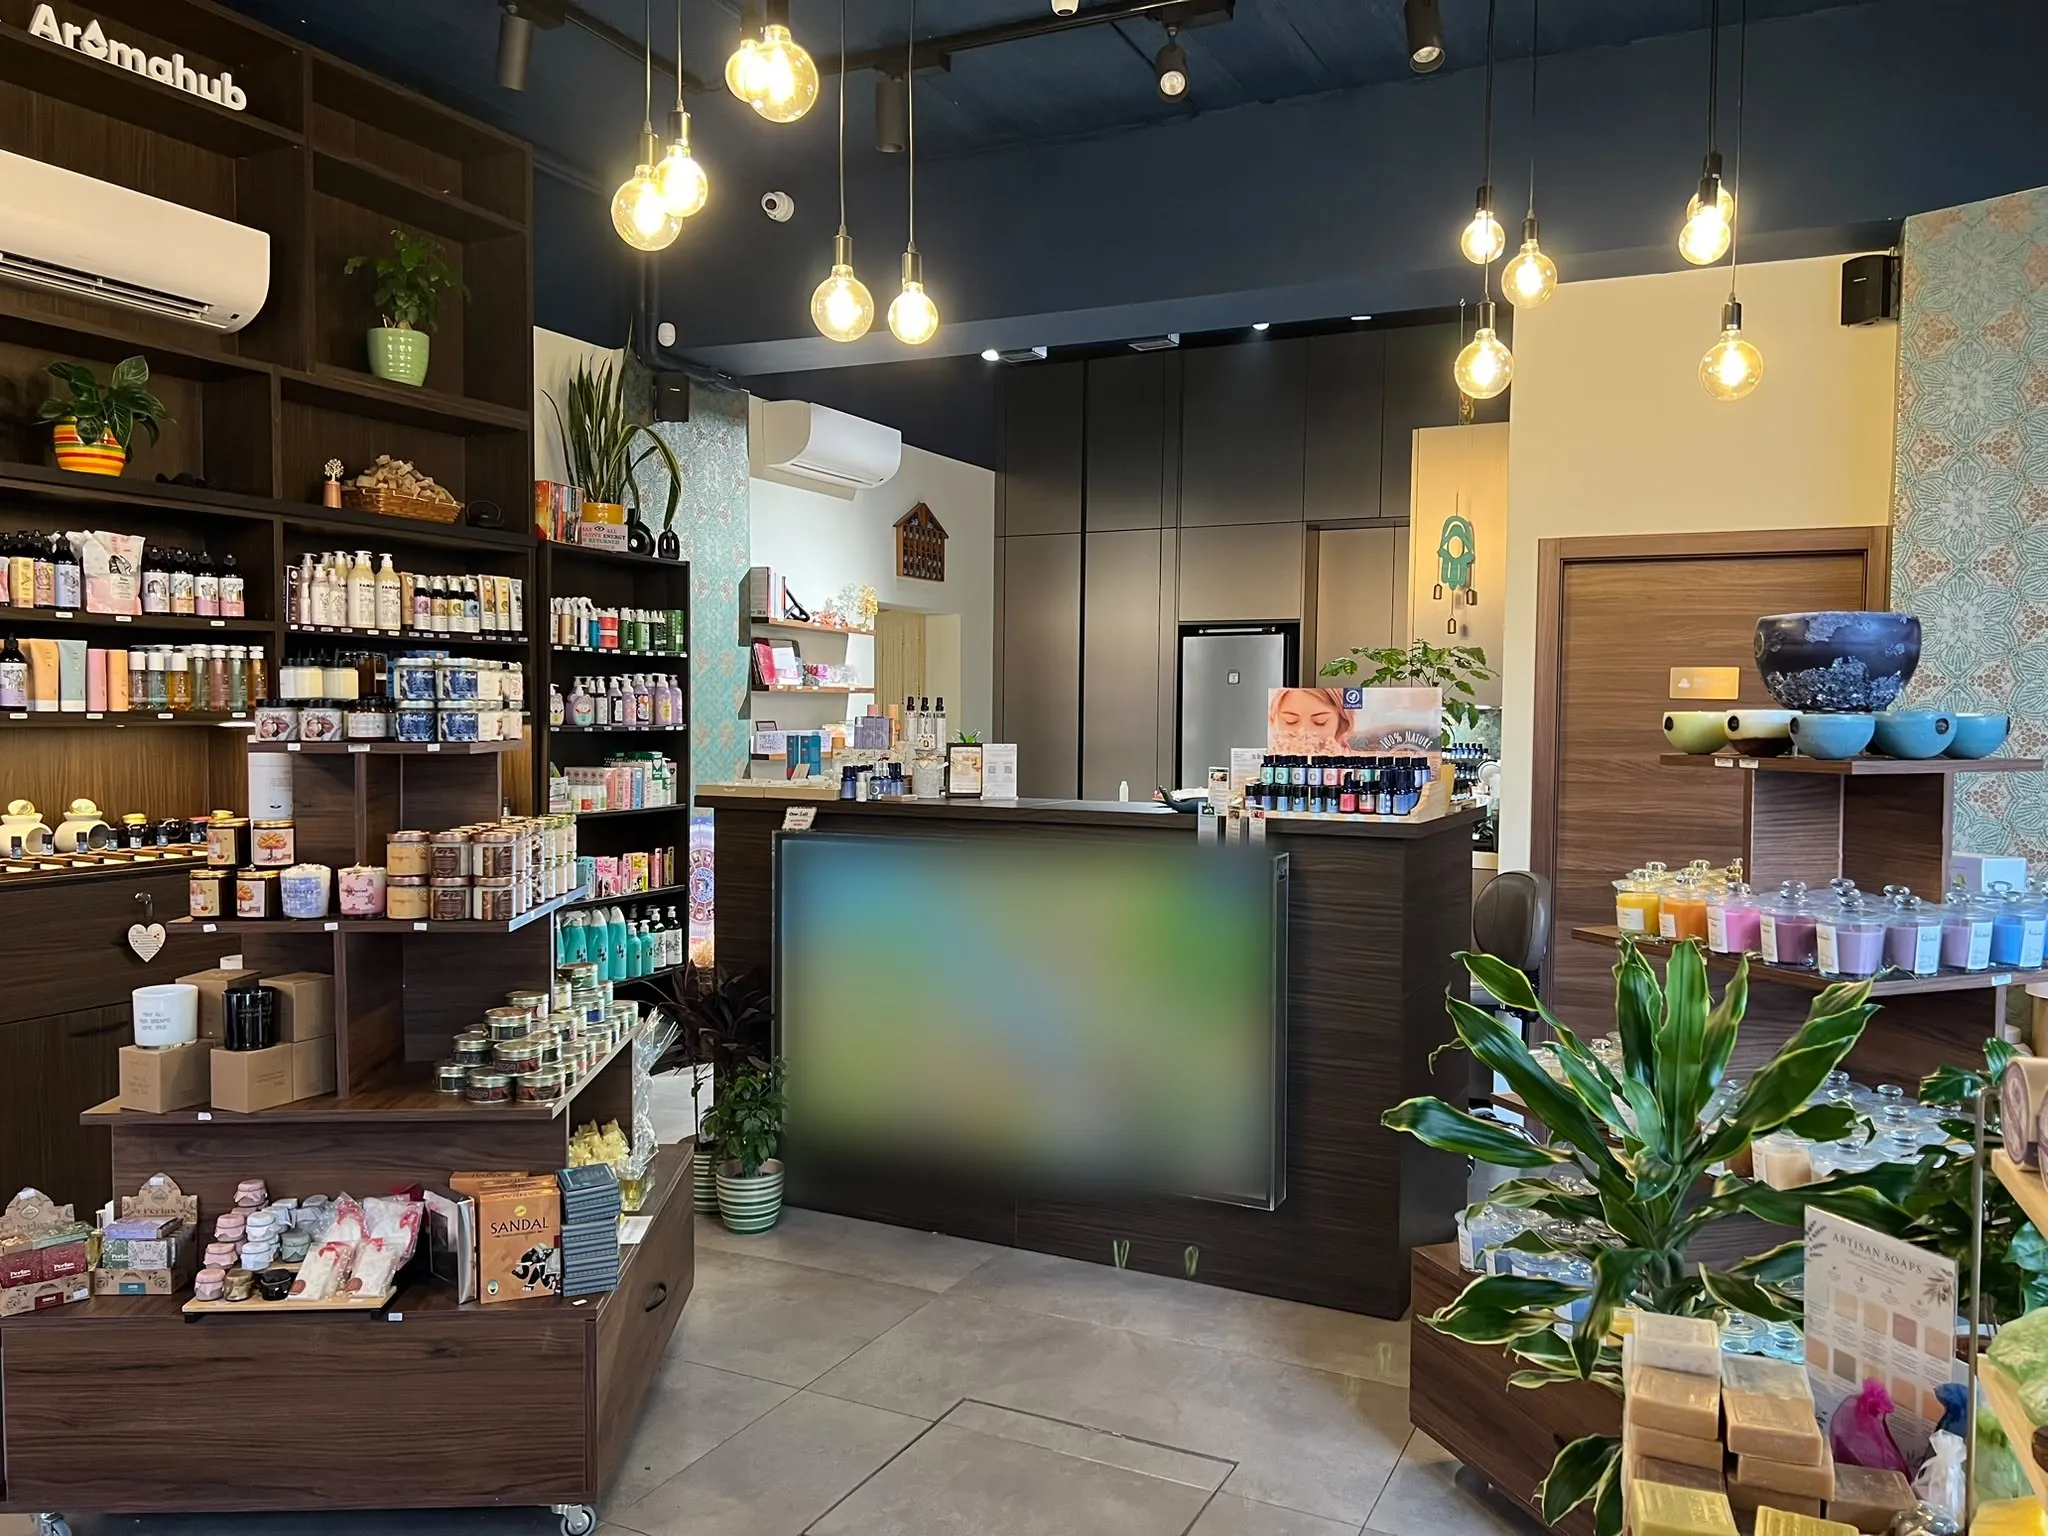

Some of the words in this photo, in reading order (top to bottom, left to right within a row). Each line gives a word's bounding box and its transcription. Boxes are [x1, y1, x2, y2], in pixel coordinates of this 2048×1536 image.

[29, 3, 247, 111] Aromahub
[1379, 732, 1403, 749] 100%
[1405, 730, 1434, 750] NATURE
[490, 1217, 549, 1235] SANDAL
[1832, 1233, 1881, 1259] ARTISAN
[1884, 1252, 1923, 1274] SOAPS
